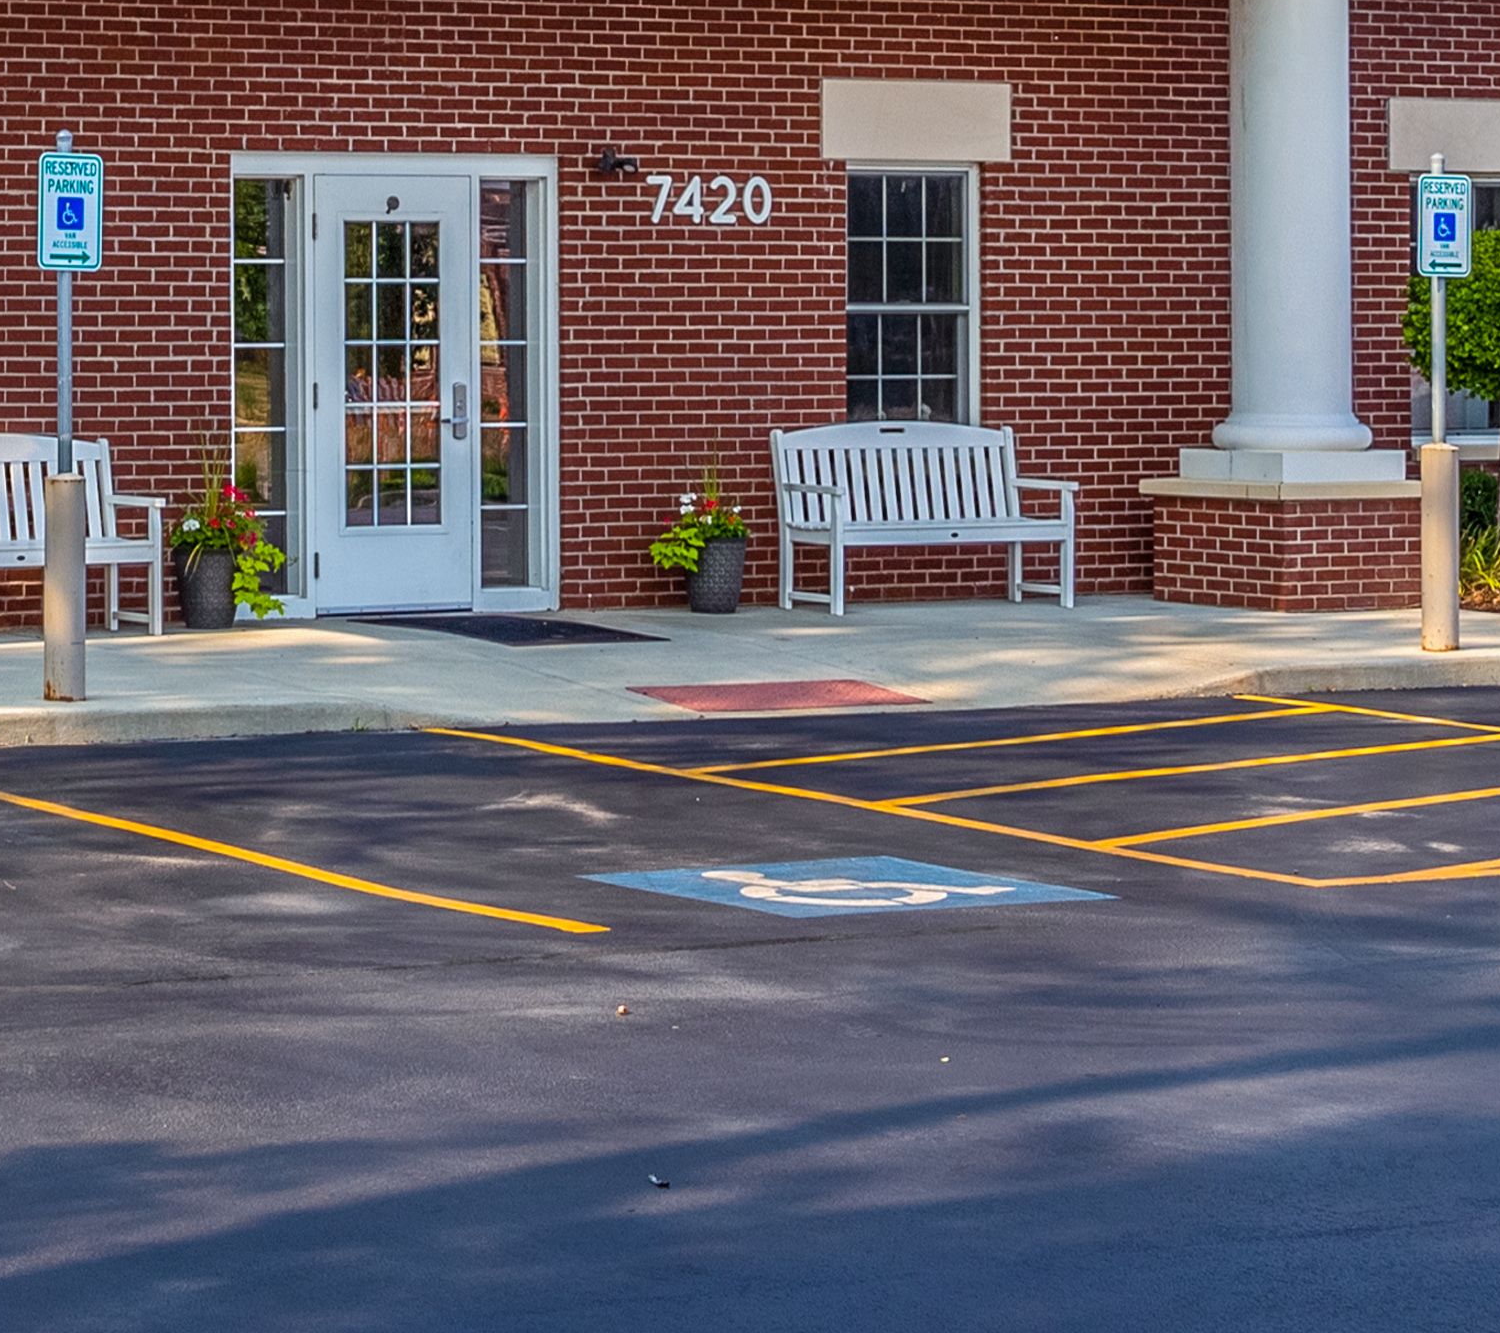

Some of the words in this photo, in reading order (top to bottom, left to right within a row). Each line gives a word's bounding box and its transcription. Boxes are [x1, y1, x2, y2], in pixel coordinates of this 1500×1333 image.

[45, 160, 98, 177] RESERVED
[47, 178, 95, 195] PARKING
[1422, 180, 1466, 195] RESERVED
[645, 174, 773, 225] 7420
[1425, 197, 1465, 211] PARKING
